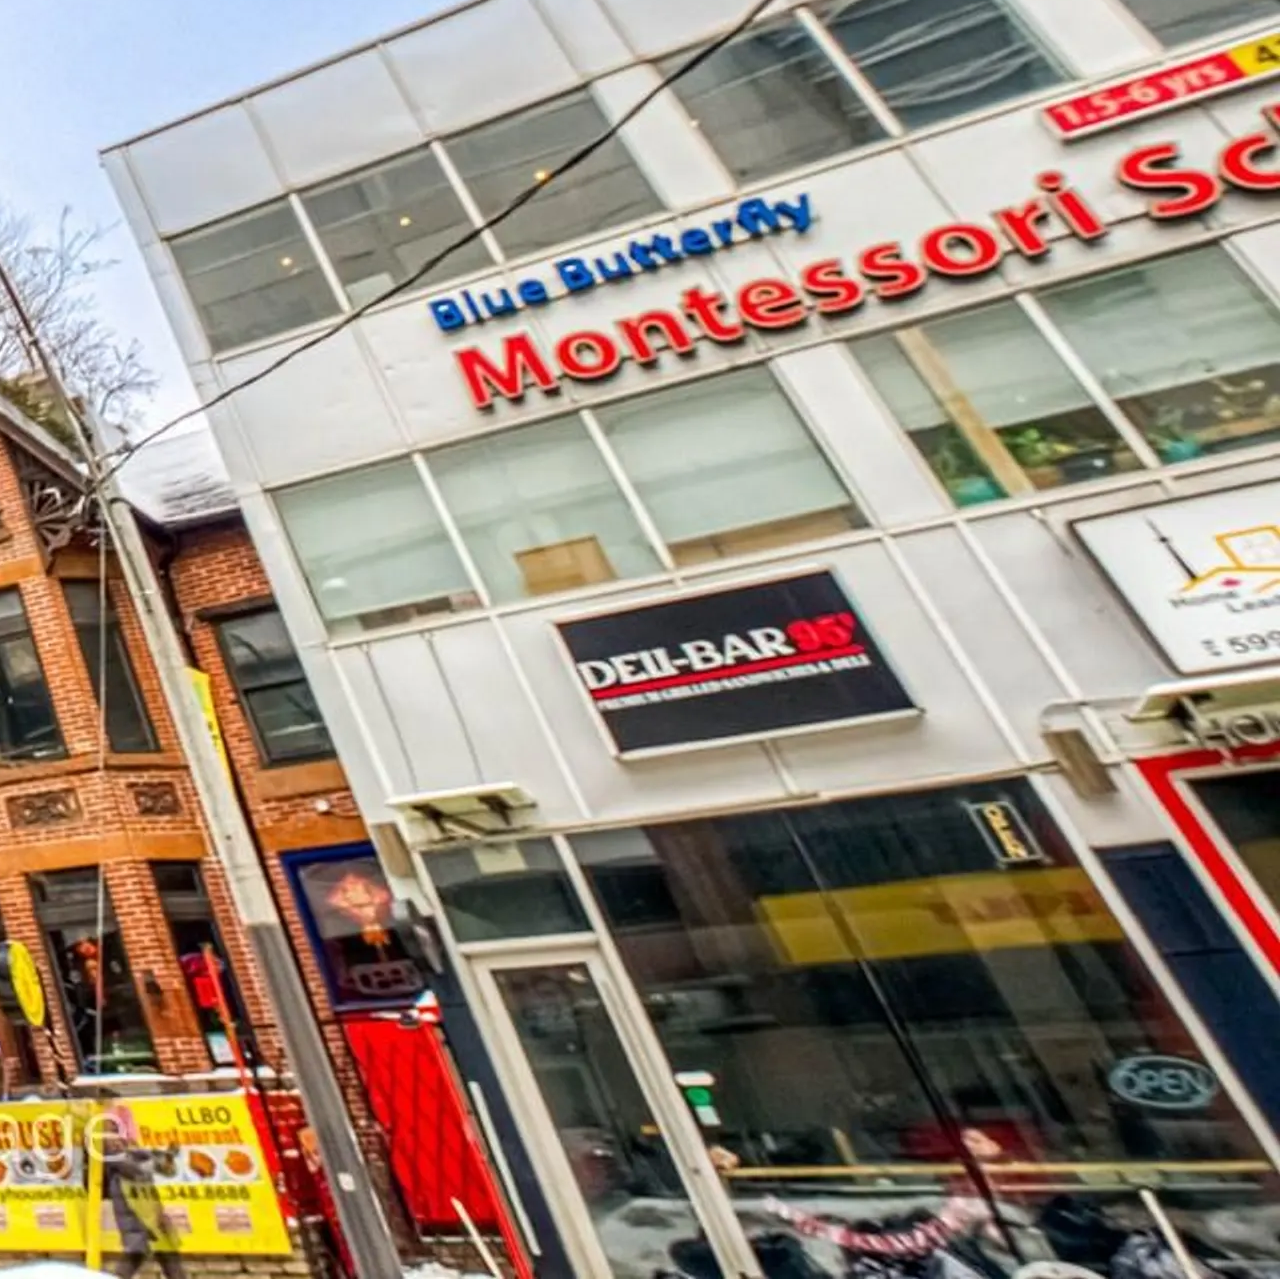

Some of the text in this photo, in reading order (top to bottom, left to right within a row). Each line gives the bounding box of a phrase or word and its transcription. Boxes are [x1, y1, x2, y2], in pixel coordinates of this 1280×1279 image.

[1160, 61, 1227, 97] yrs
[428, 192, 813, 332] Blue Butterfly
[454, 171, 1106, 410] Montessori
[1121, 1066, 1210, 1097] OPEN
[140, 1126, 245, 1145] Restaurant
